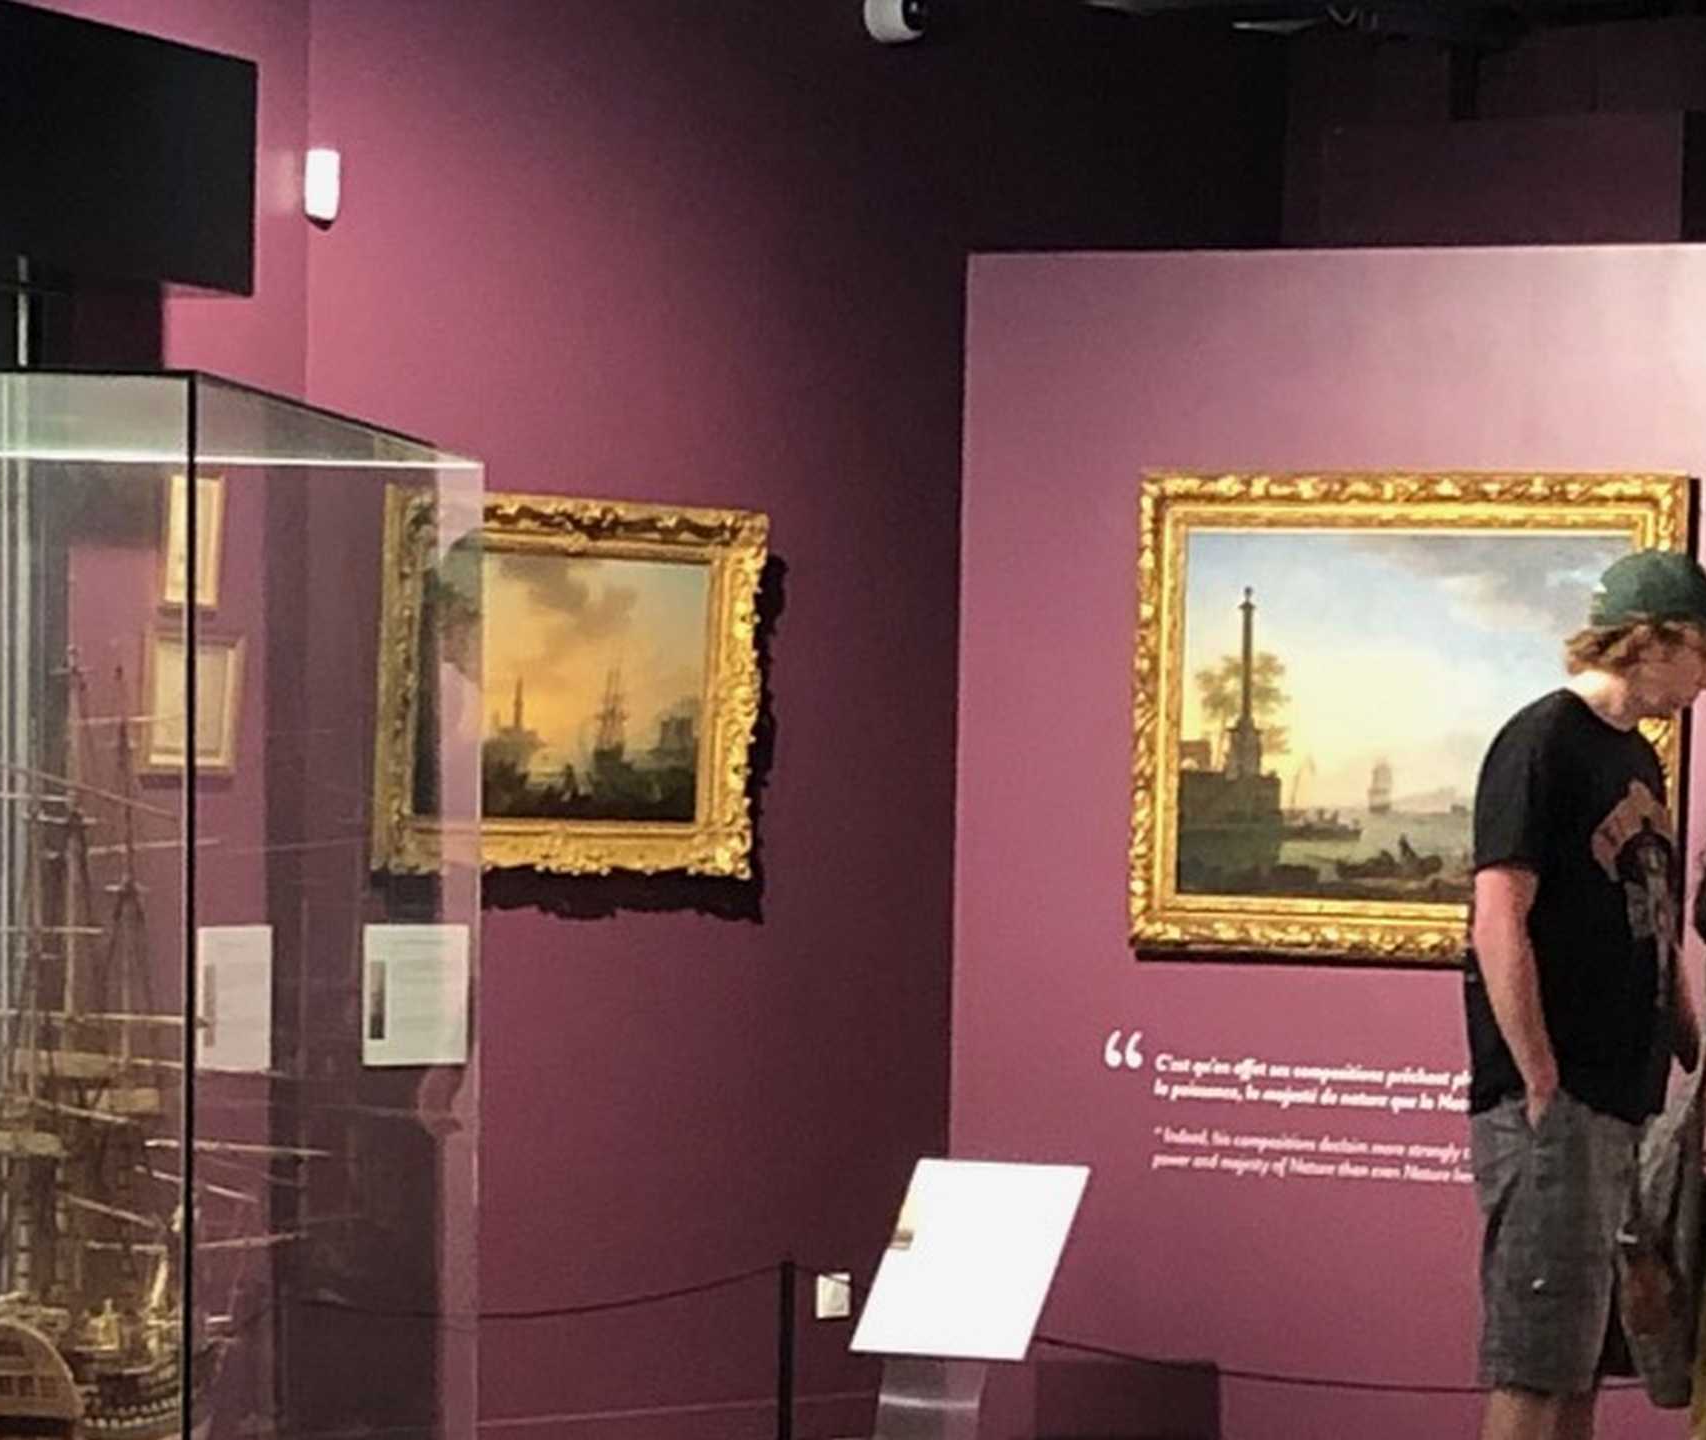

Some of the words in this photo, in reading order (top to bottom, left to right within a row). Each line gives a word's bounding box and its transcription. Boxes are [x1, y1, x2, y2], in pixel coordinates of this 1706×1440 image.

[1233, 1058, 1267, 1081] effet
[1293, 1063, 1385, 1086] compositions
[1233, 1133, 1316, 1154] compositions
[1408, 1142, 1462, 1164] strongly
[1152, 1154, 1191, 1170] power
[1192, 1153, 1219, 1169] and
[1220, 1158, 1270, 1177] majesty
[1272, 1156, 1289, 1178] of
[1289, 1157, 1336, 1176] Nature
[1403, 1163, 1451, 1182] Nature
